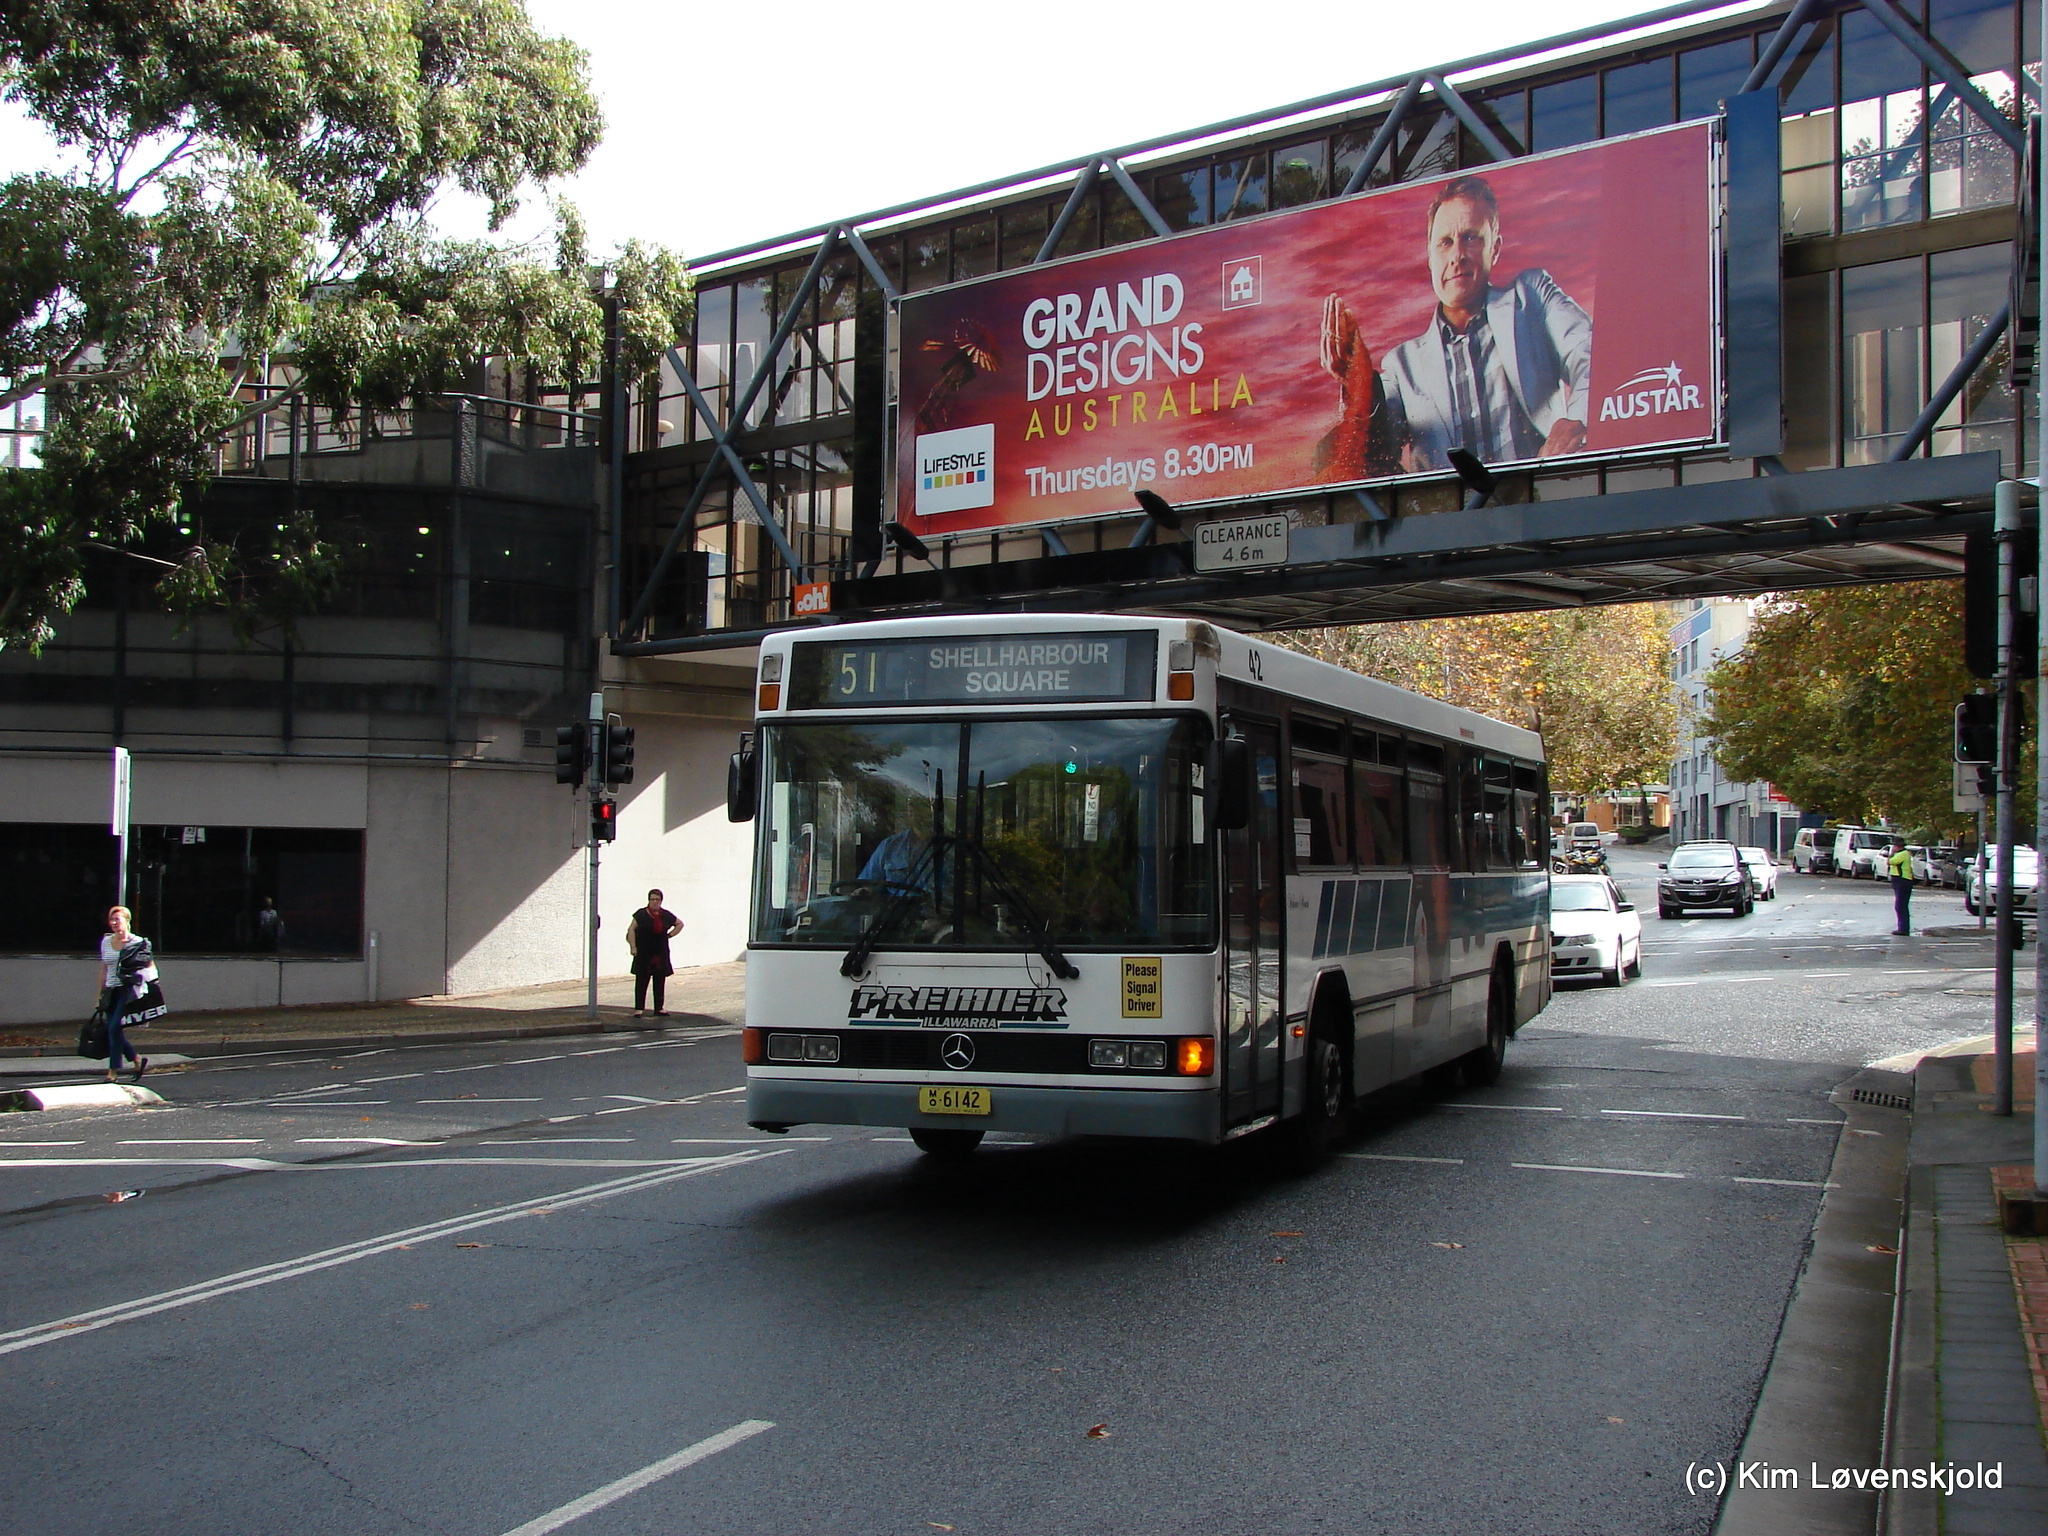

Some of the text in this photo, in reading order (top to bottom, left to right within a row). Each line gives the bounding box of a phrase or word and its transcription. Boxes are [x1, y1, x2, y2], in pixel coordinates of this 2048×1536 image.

[1023, 273, 1185, 349] GRAND
[1027, 322, 1205, 401] DESIGNS
[1024, 373, 1255, 441] AUSTRALIA
[1599, 384, 1699, 422] AUSTAR
[1025, 443, 1255, 497] Thursdays 8.30PM
[1201, 522, 1282, 545] CLEARANCE
[1222, 546, 1264, 562] 4.6m
[929, 643, 1110, 669] SHELLHARBOUR
[1248, 648, 1264, 682] 42
[840, 652, 877, 695] 51
[965, 669, 1070, 694] SQUARE
[1125, 963, 1158, 977] Please
[1127, 981, 1157, 997] Signal
[849, 985, 1068, 1019] PREMIER
[1127, 998, 1156, 1012] Driver
[120, 1004, 168, 1026] MYER
[923, 1016, 999, 1029] ILLAWARRA
[943, 1090, 981, 1109] 6142
